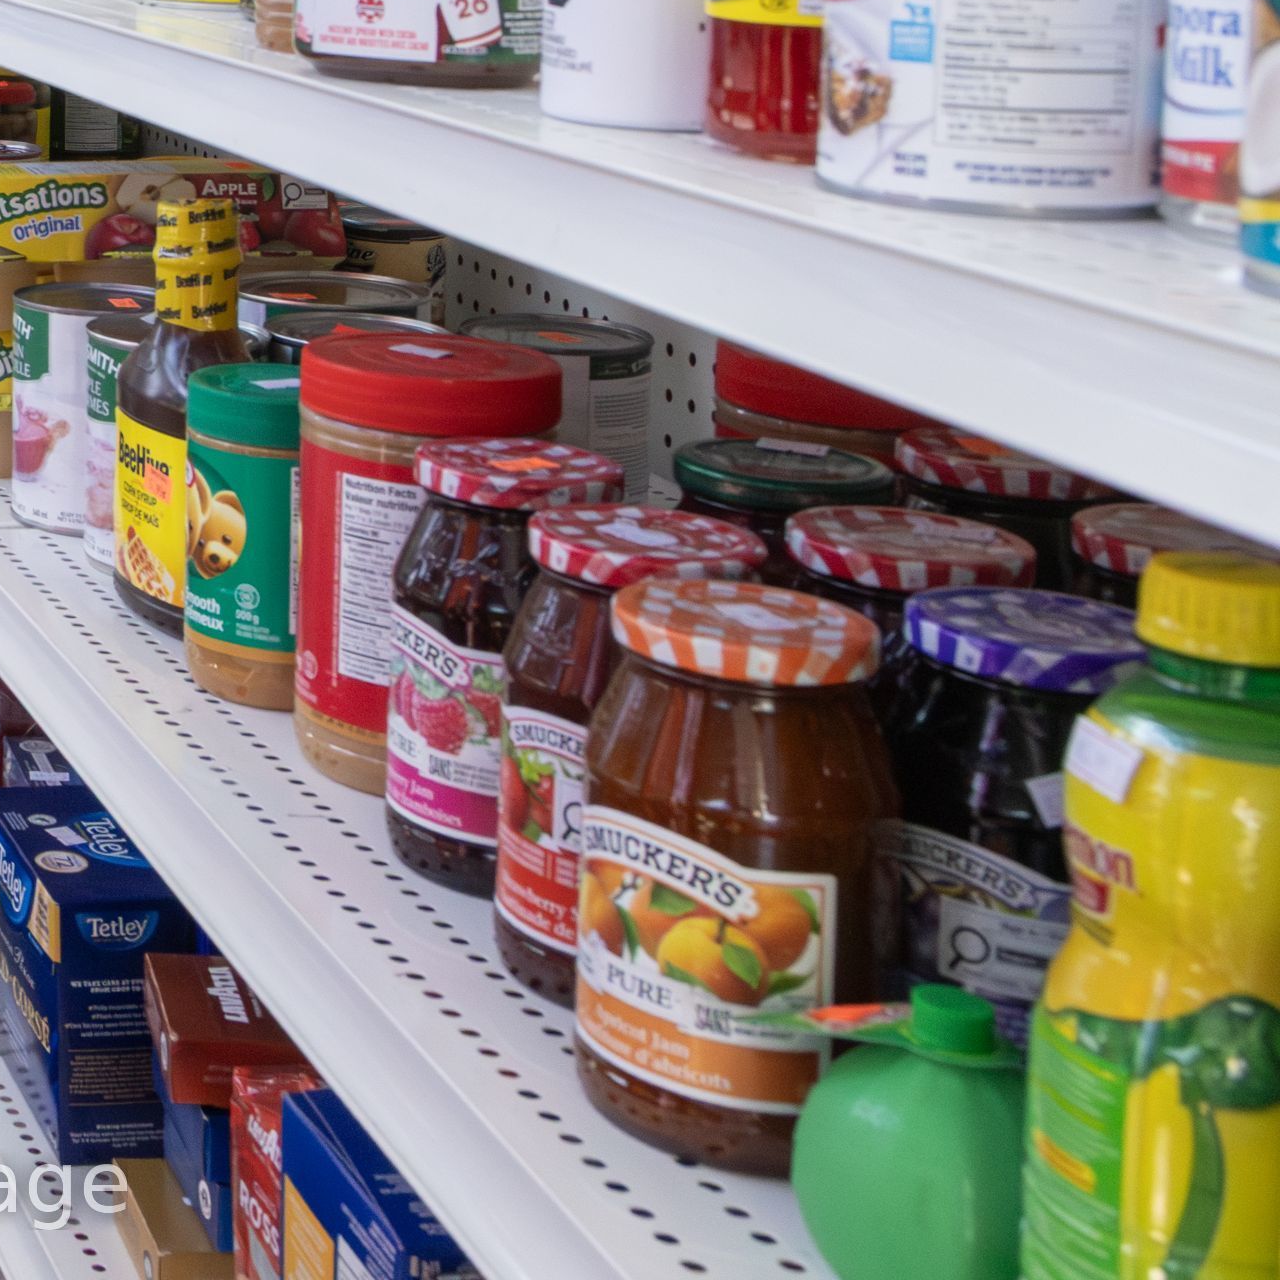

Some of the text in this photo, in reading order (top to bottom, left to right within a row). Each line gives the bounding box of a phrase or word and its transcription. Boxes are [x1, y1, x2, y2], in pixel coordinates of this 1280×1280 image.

[202, 179, 258, 198] APPLE
[13, 215, 84, 241] Original
[344, 477, 385, 494] Nutrition
[514, 724, 585, 755] SMUCKE
[583, 824, 743, 907] SMUCKER'S
[86, 916, 149, 946] Tetley
[606, 962, 674, 1010] PURE
